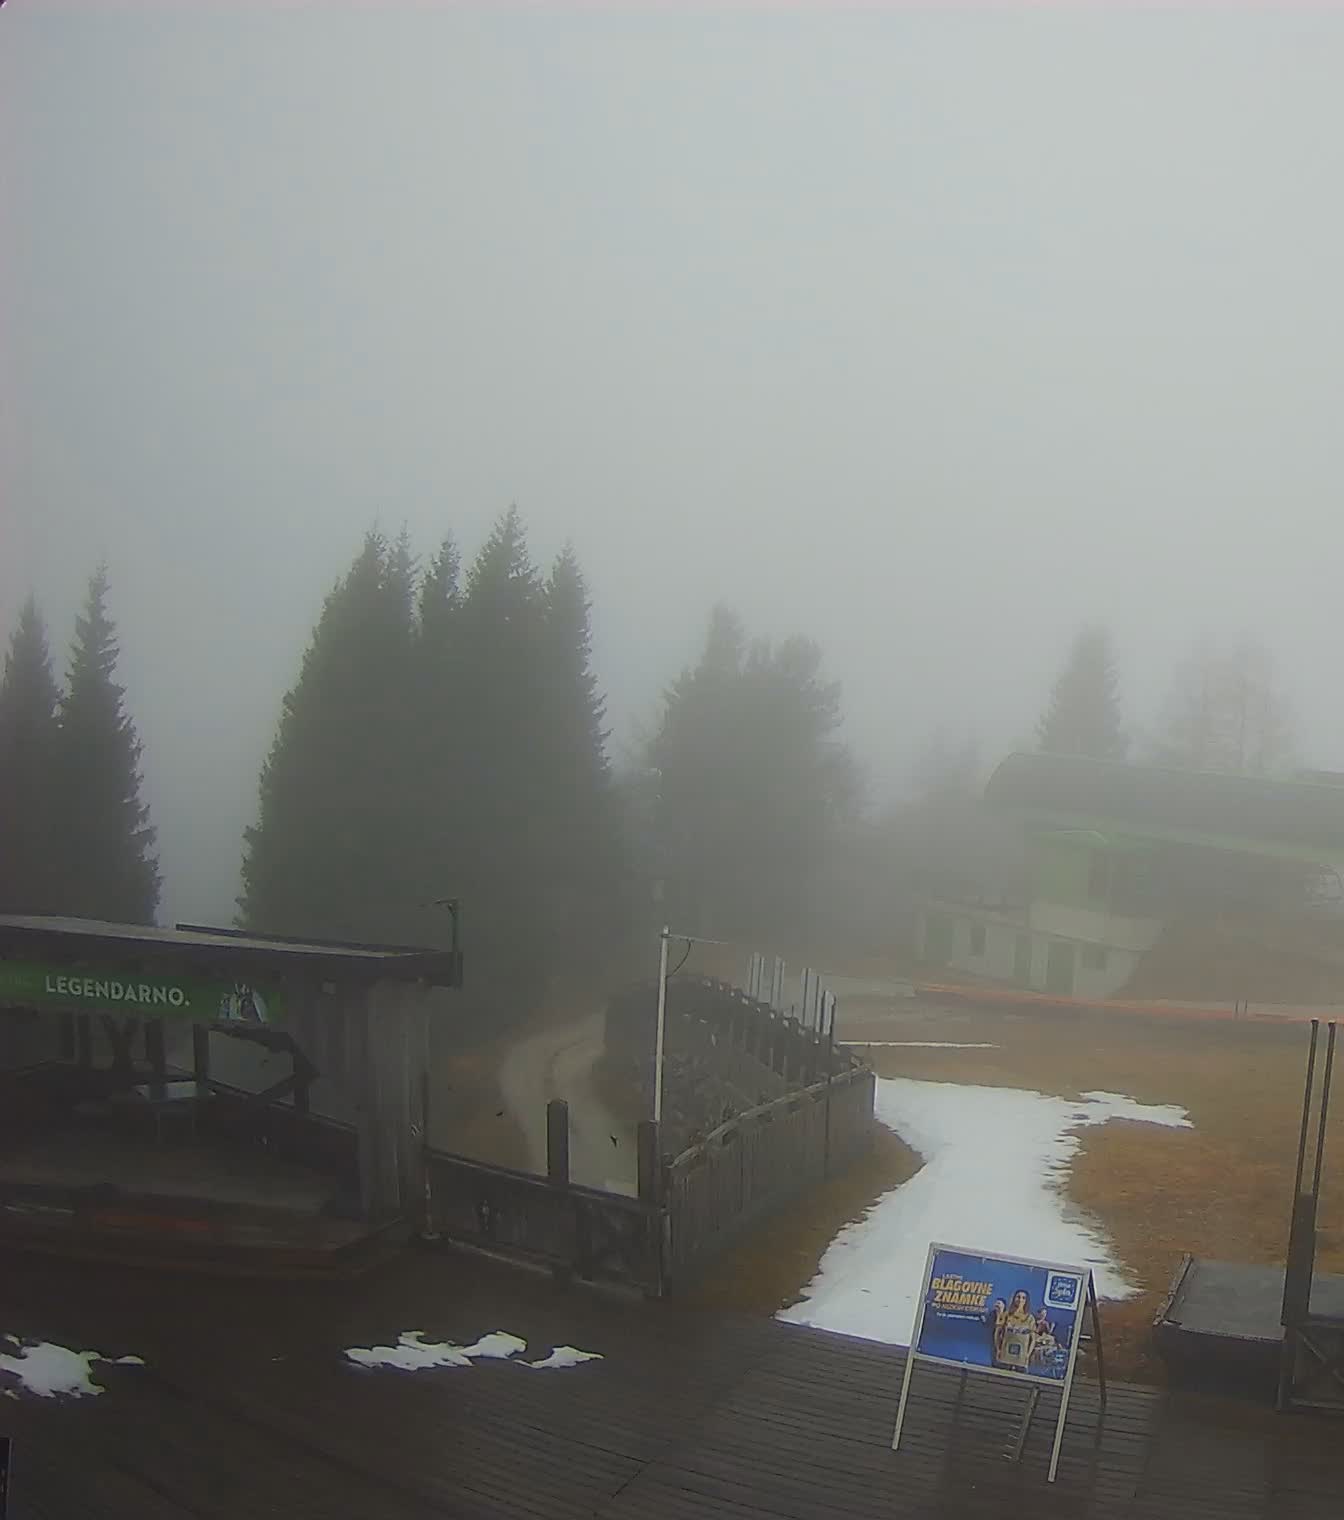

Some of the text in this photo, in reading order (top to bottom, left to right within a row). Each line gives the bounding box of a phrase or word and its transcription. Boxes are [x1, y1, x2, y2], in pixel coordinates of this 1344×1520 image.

[46, 975, 190, 1006] LEGENDARNO.
[932, 1277, 993, 1296] BLAGOVNE
[934, 1290, 987, 1307] ZNAMKE
